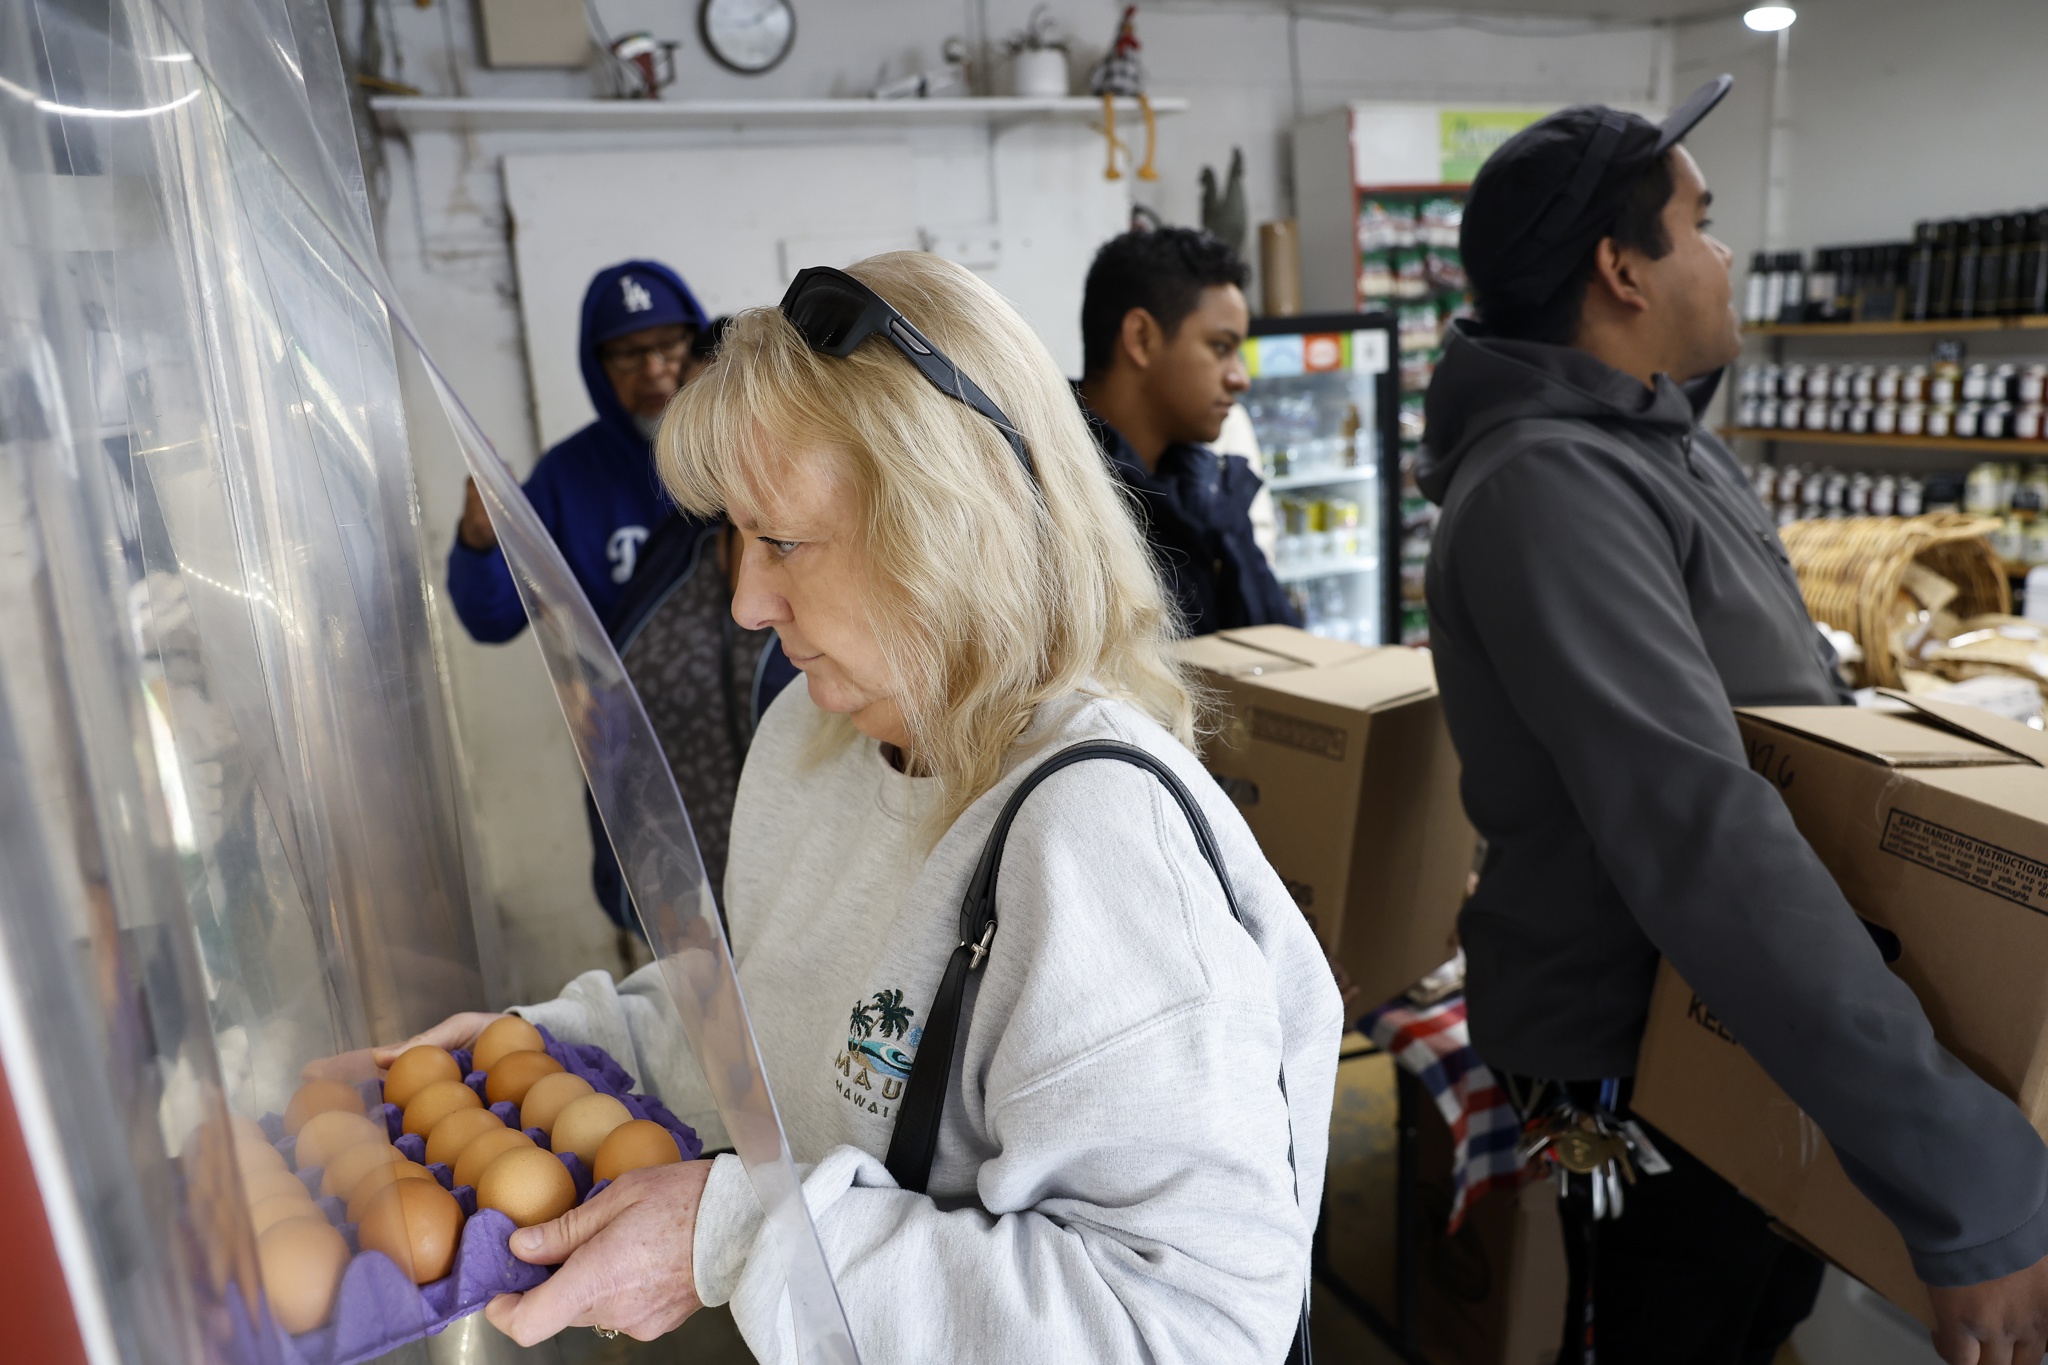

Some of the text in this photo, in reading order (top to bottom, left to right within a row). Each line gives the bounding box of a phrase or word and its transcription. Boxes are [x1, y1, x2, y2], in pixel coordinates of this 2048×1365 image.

[618, 275, 654, 314] LA
[1900, 816, 2048, 879] SAFE HANDLING INSTRUCTIONS
[1901, 829, 1930, 843] prevent
[1930, 839, 1955, 853] illness
[1957, 848, 1975, 861] from
[2015, 871, 2035, 885] Keep
[1936, 859, 1970, 879] containing
[1972, 874, 1989, 885] eggs
[1955, 859, 1972, 869] eggs
[1976, 866, 1993, 877] until
[1997, 875, 2016, 886] yolks
[2021, 884, 2033, 893] are
[835, 1079, 900, 1122] HAWAI
